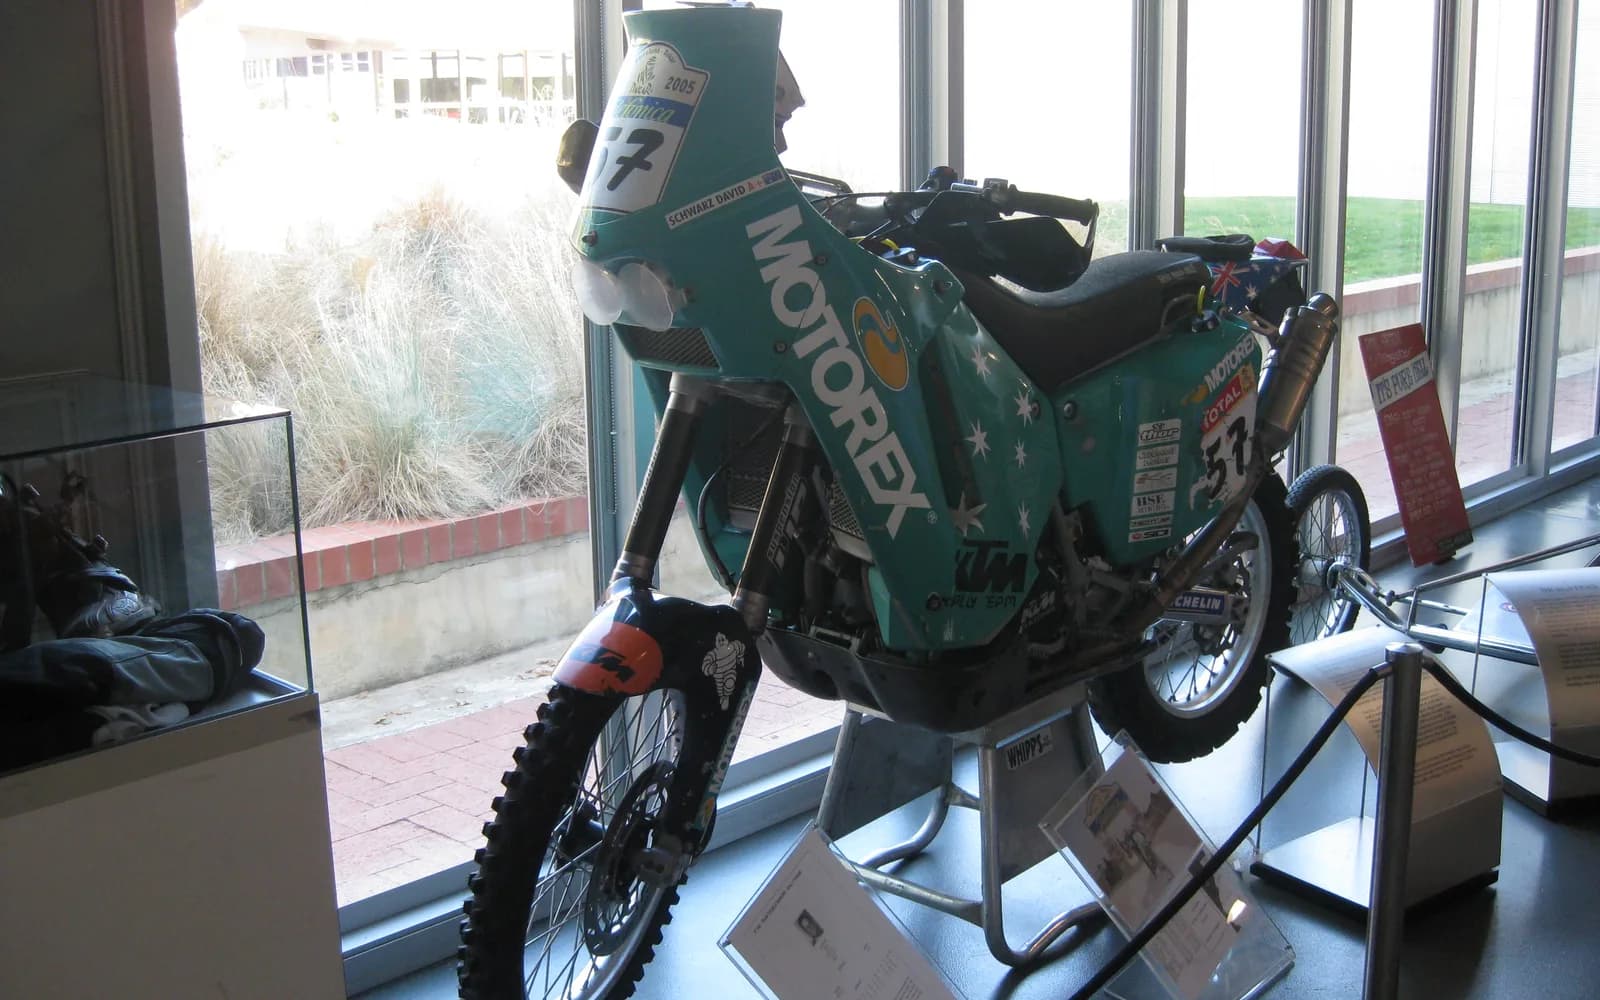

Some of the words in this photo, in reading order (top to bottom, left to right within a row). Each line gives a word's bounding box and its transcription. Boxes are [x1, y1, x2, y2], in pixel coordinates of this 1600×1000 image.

[664, 76, 696, 94] 2005
[668, 199, 715, 226] SCHWARZ
[715, 185, 746, 205] DAVID
[745, 205, 932, 540] MOTOREX
[1202, 386, 1242, 430] TOTAL
[1206, 416, 1248, 499] 57
[954, 538, 1028, 593] KTM
